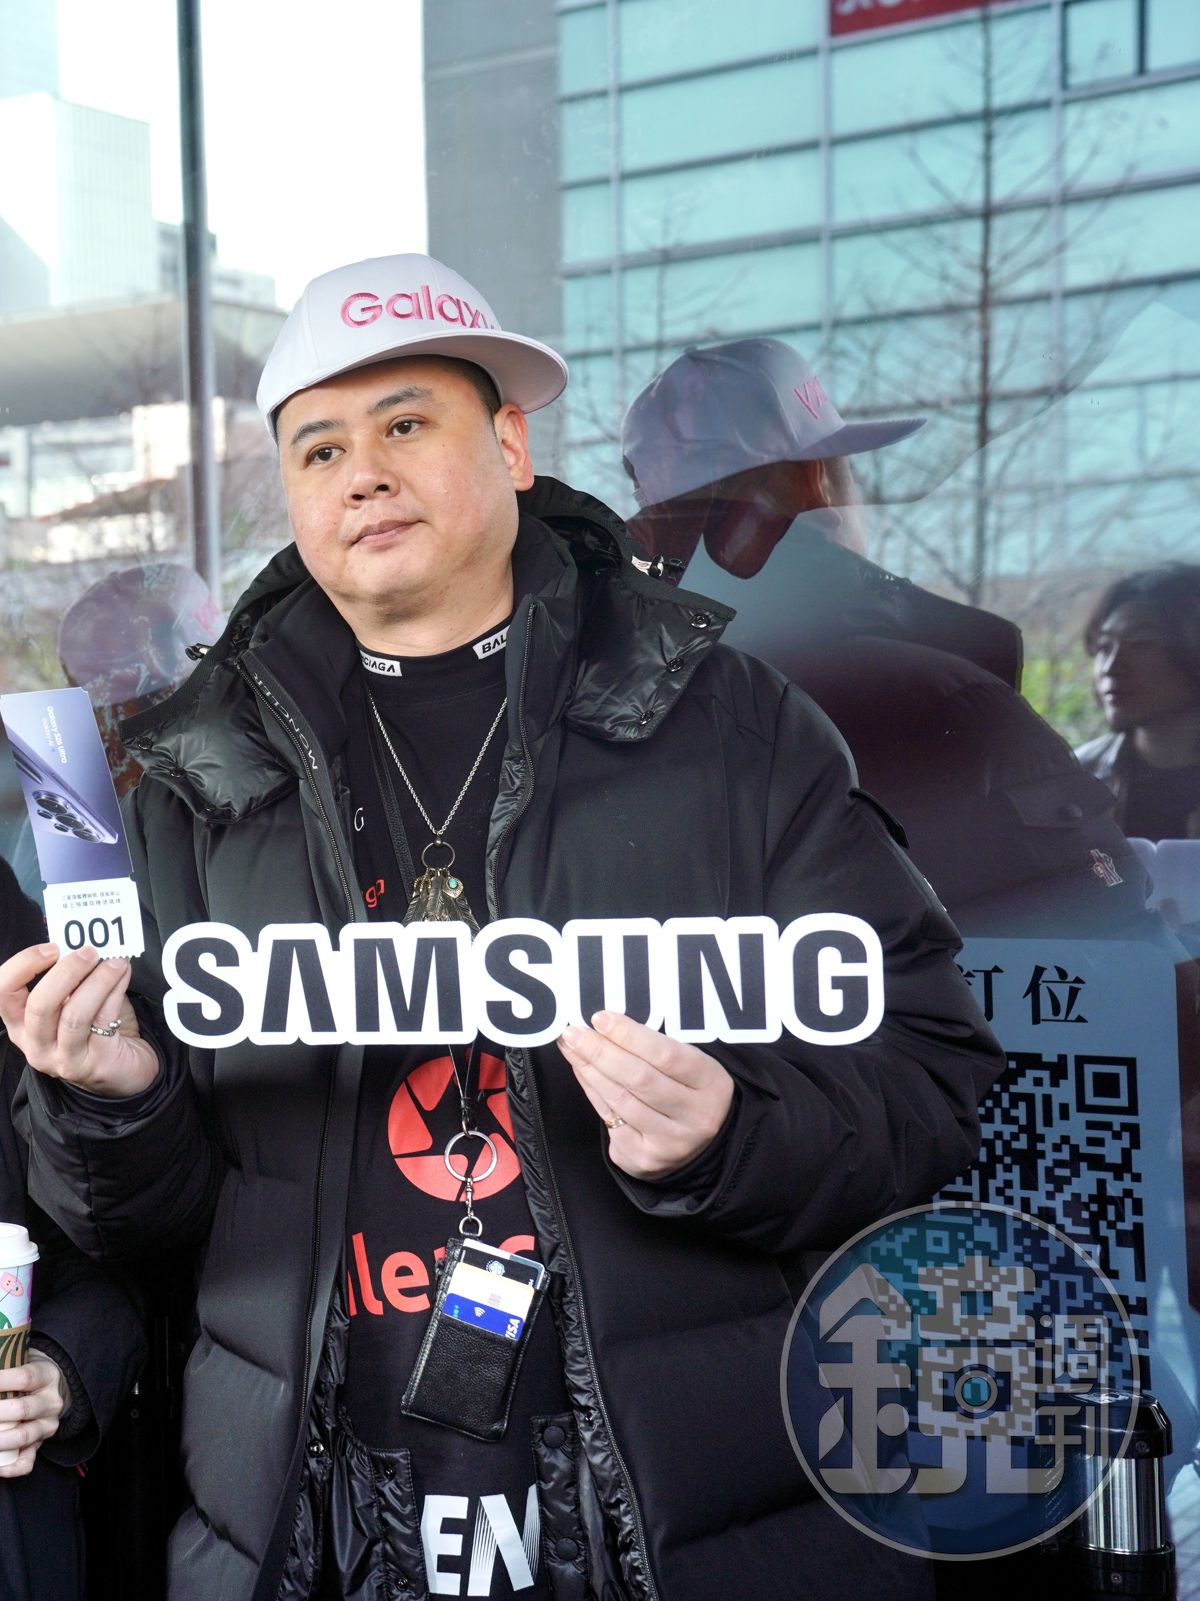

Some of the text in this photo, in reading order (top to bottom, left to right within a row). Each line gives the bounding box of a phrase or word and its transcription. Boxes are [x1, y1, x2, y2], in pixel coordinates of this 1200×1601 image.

[340, 285, 495, 330] Galax
[362, 655, 396, 674] CIAGA
[64, 915, 125, 951] 001
[174, 929, 870, 1037] SAMSUNG
